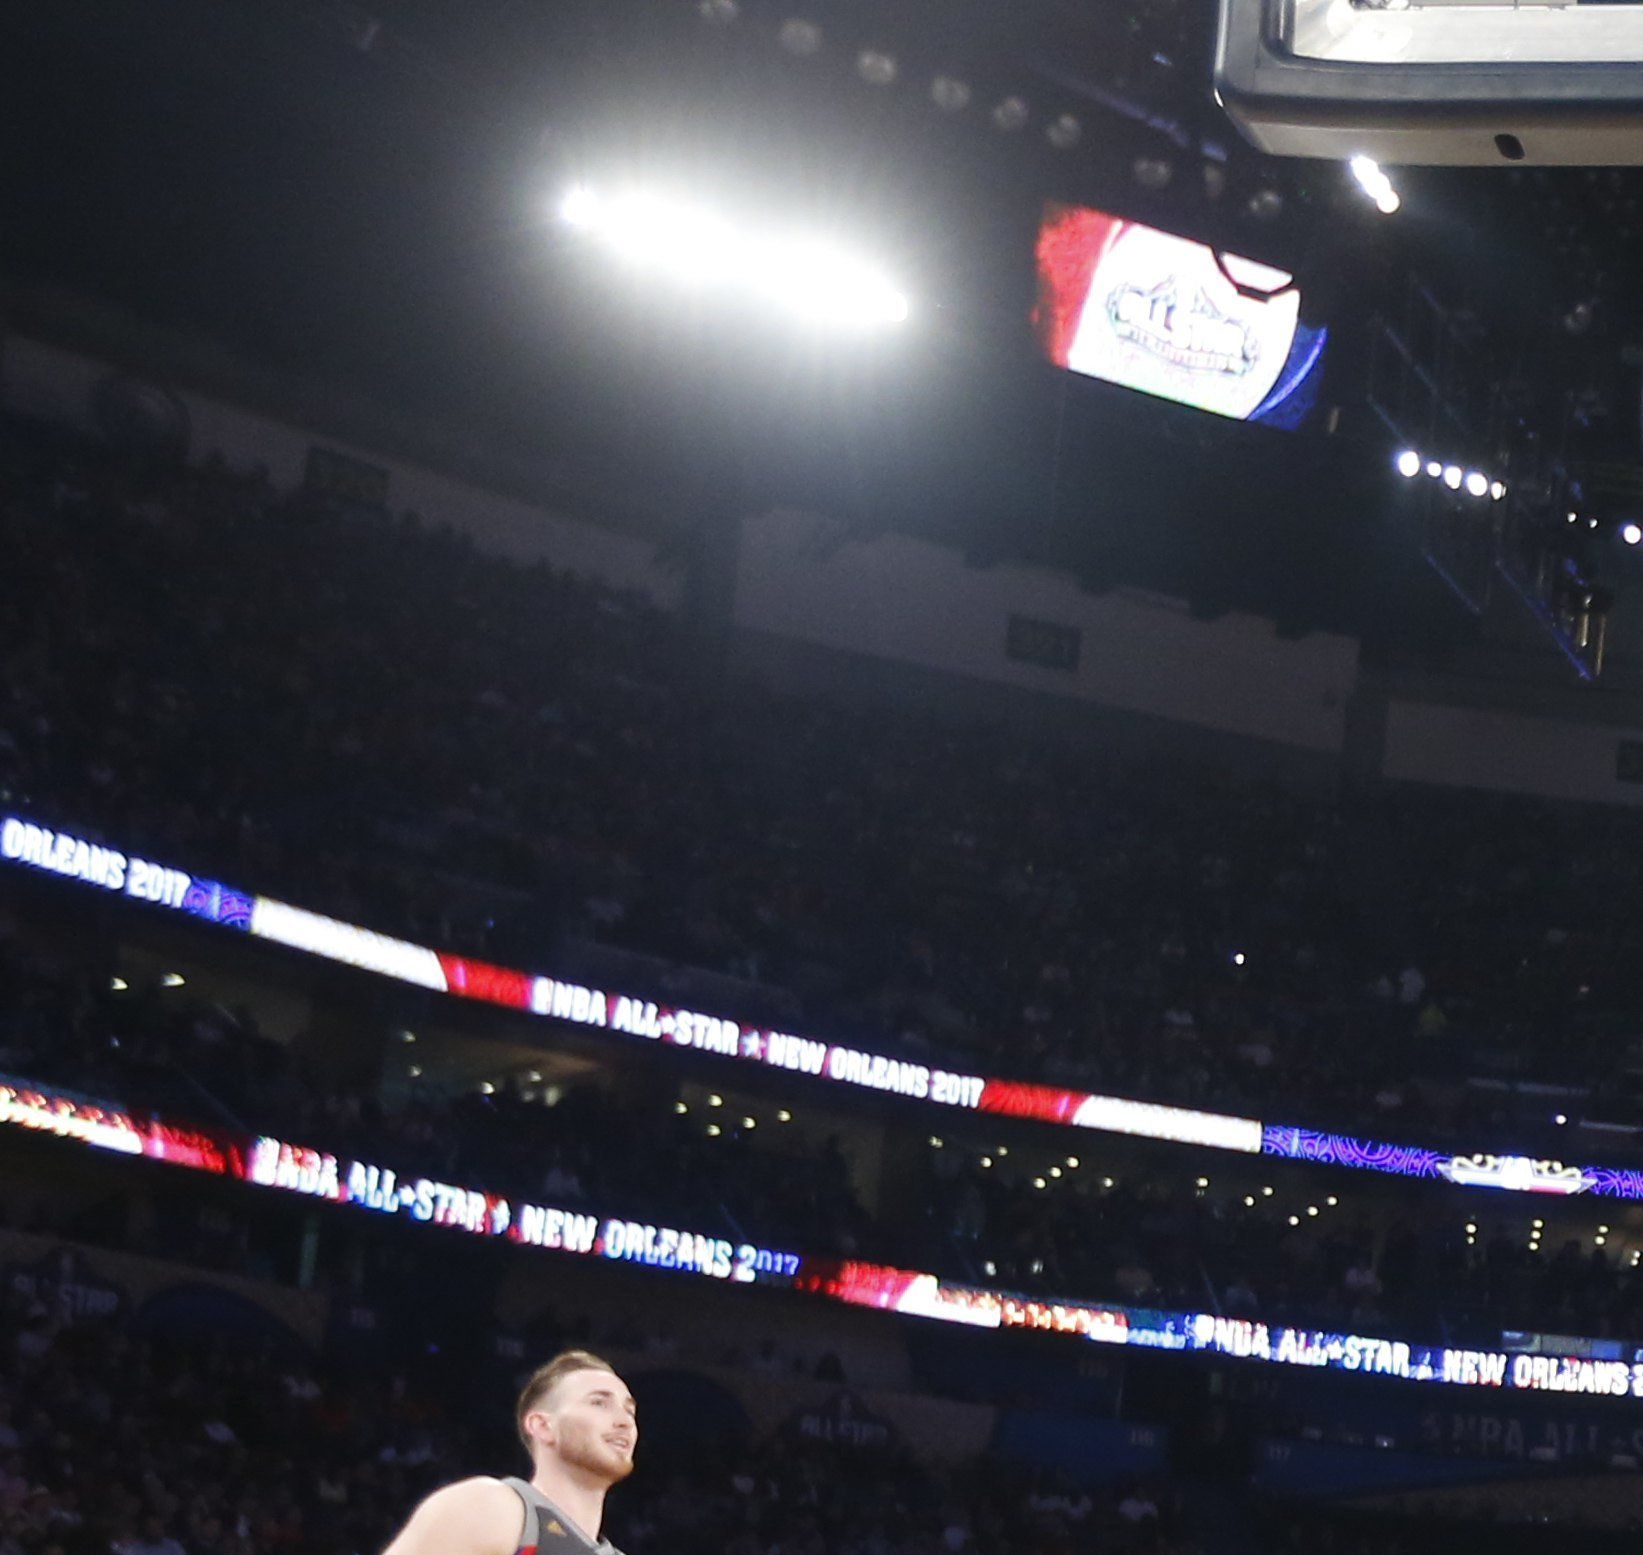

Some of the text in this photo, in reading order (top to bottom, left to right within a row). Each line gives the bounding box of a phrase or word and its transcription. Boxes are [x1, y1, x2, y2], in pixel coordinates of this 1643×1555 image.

[129, 858, 191, 909] 2017
[551, 979, 607, 1027] NBA
[768, 1029, 826, 1076] NEW
[830, 1052, 928, 1099] ORLEANS
[931, 1070, 985, 1109] 2017
[521, 1203, 598, 1254] NEW
[604, 1217, 734, 1278] ORLEANS
[1443, 1348, 1506, 1386] NEW
[1513, 1355, 1630, 1396] ORLEANS
